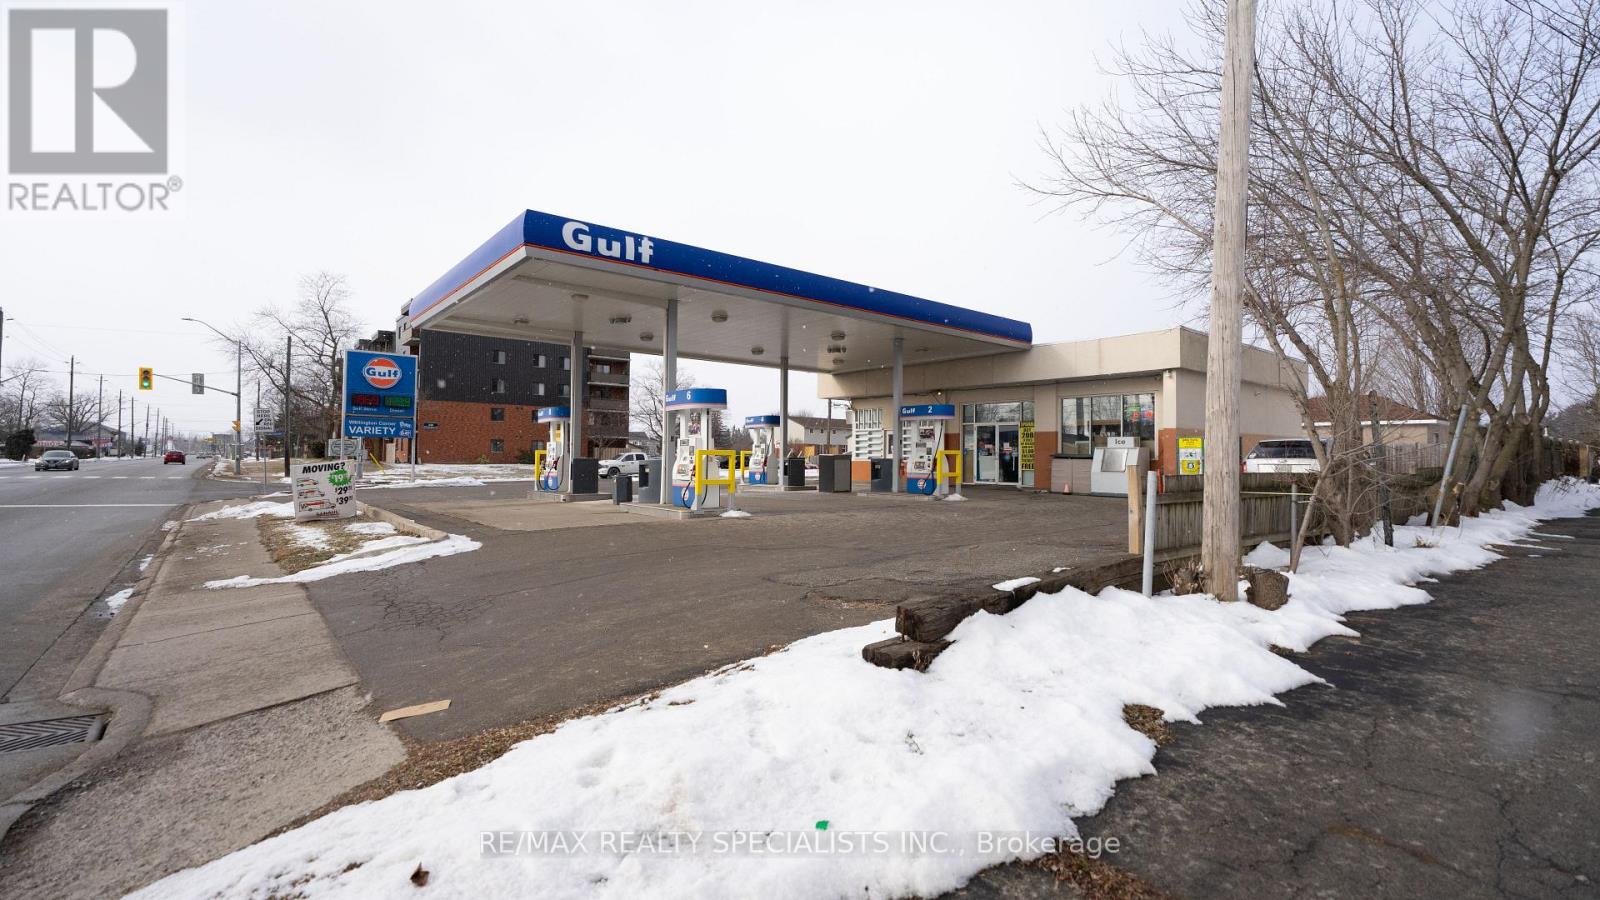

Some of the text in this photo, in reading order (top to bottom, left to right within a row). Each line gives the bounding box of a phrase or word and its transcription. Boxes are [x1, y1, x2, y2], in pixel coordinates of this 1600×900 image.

[562, 221, 654, 264] Gulf
[366, 367, 399, 377] Gulf
[686, 391, 692, 400] 6
[928, 405, 933, 413] 2
[348, 426, 396, 435] VARIETY
[302, 462, 346, 474] MOVING?
